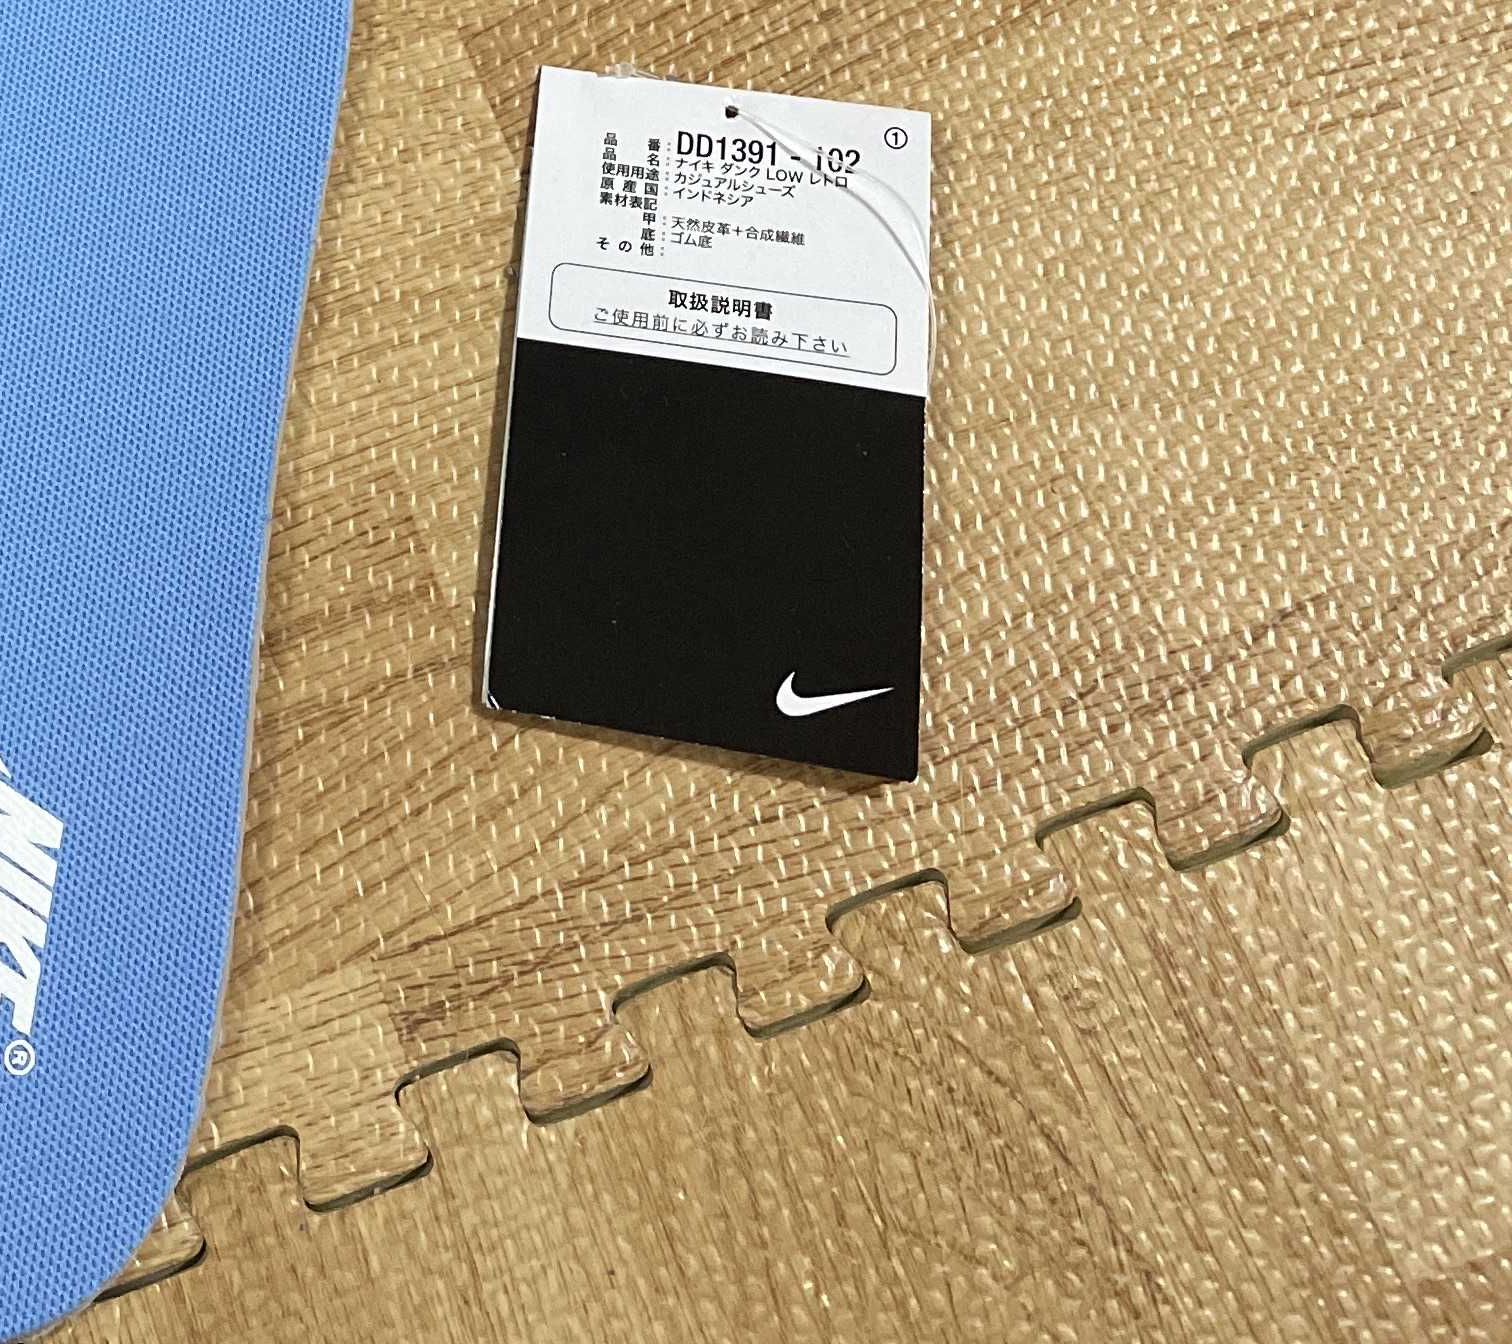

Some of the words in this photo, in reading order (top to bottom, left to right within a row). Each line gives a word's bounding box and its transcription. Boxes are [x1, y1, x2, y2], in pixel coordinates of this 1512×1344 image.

[677, 131, 777, 166] DD1391
[766, 168, 803, 184] LOW
[673, 187, 754, 208] インドネシア
[668, 289, 773, 321] 取扱説明書
[593, 307, 848, 354] ご使用前に必ずお読み下さい
